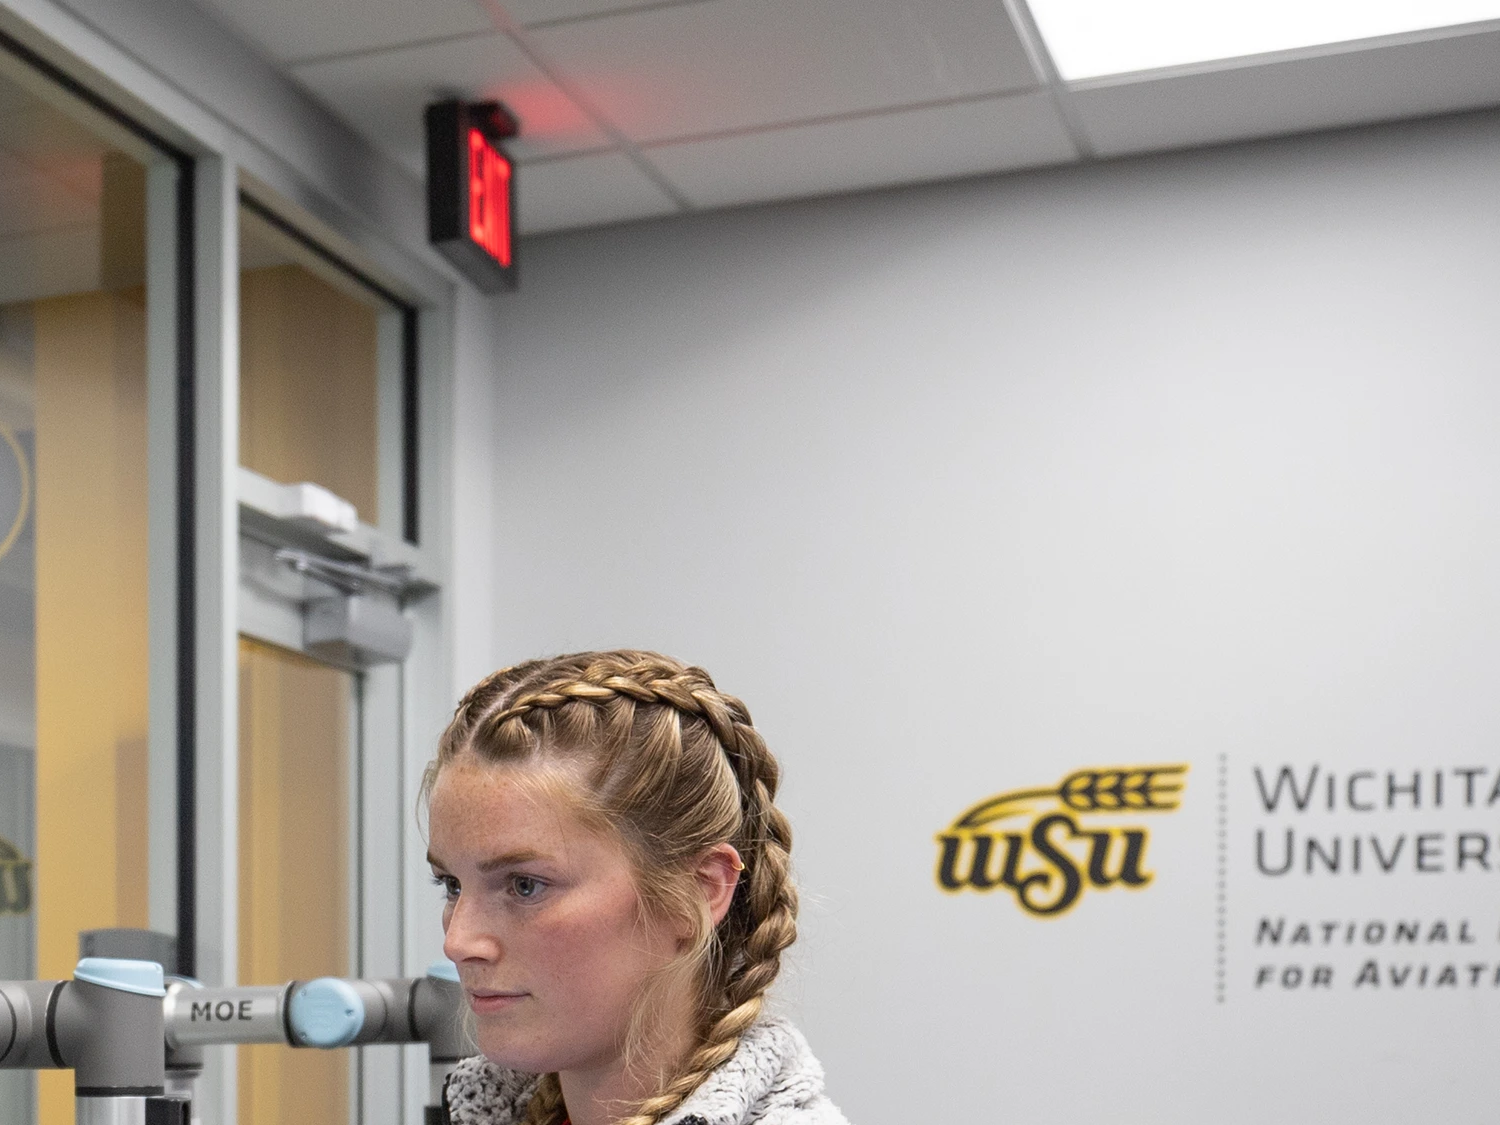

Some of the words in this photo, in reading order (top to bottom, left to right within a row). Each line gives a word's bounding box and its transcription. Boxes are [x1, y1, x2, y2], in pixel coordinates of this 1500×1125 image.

[1254, 828, 1500, 877] UNIVER
[1255, 917, 1476, 947] NATIONAL
[1255, 964, 1333, 990] FOR
[191, 1000, 253, 1022] MOE
